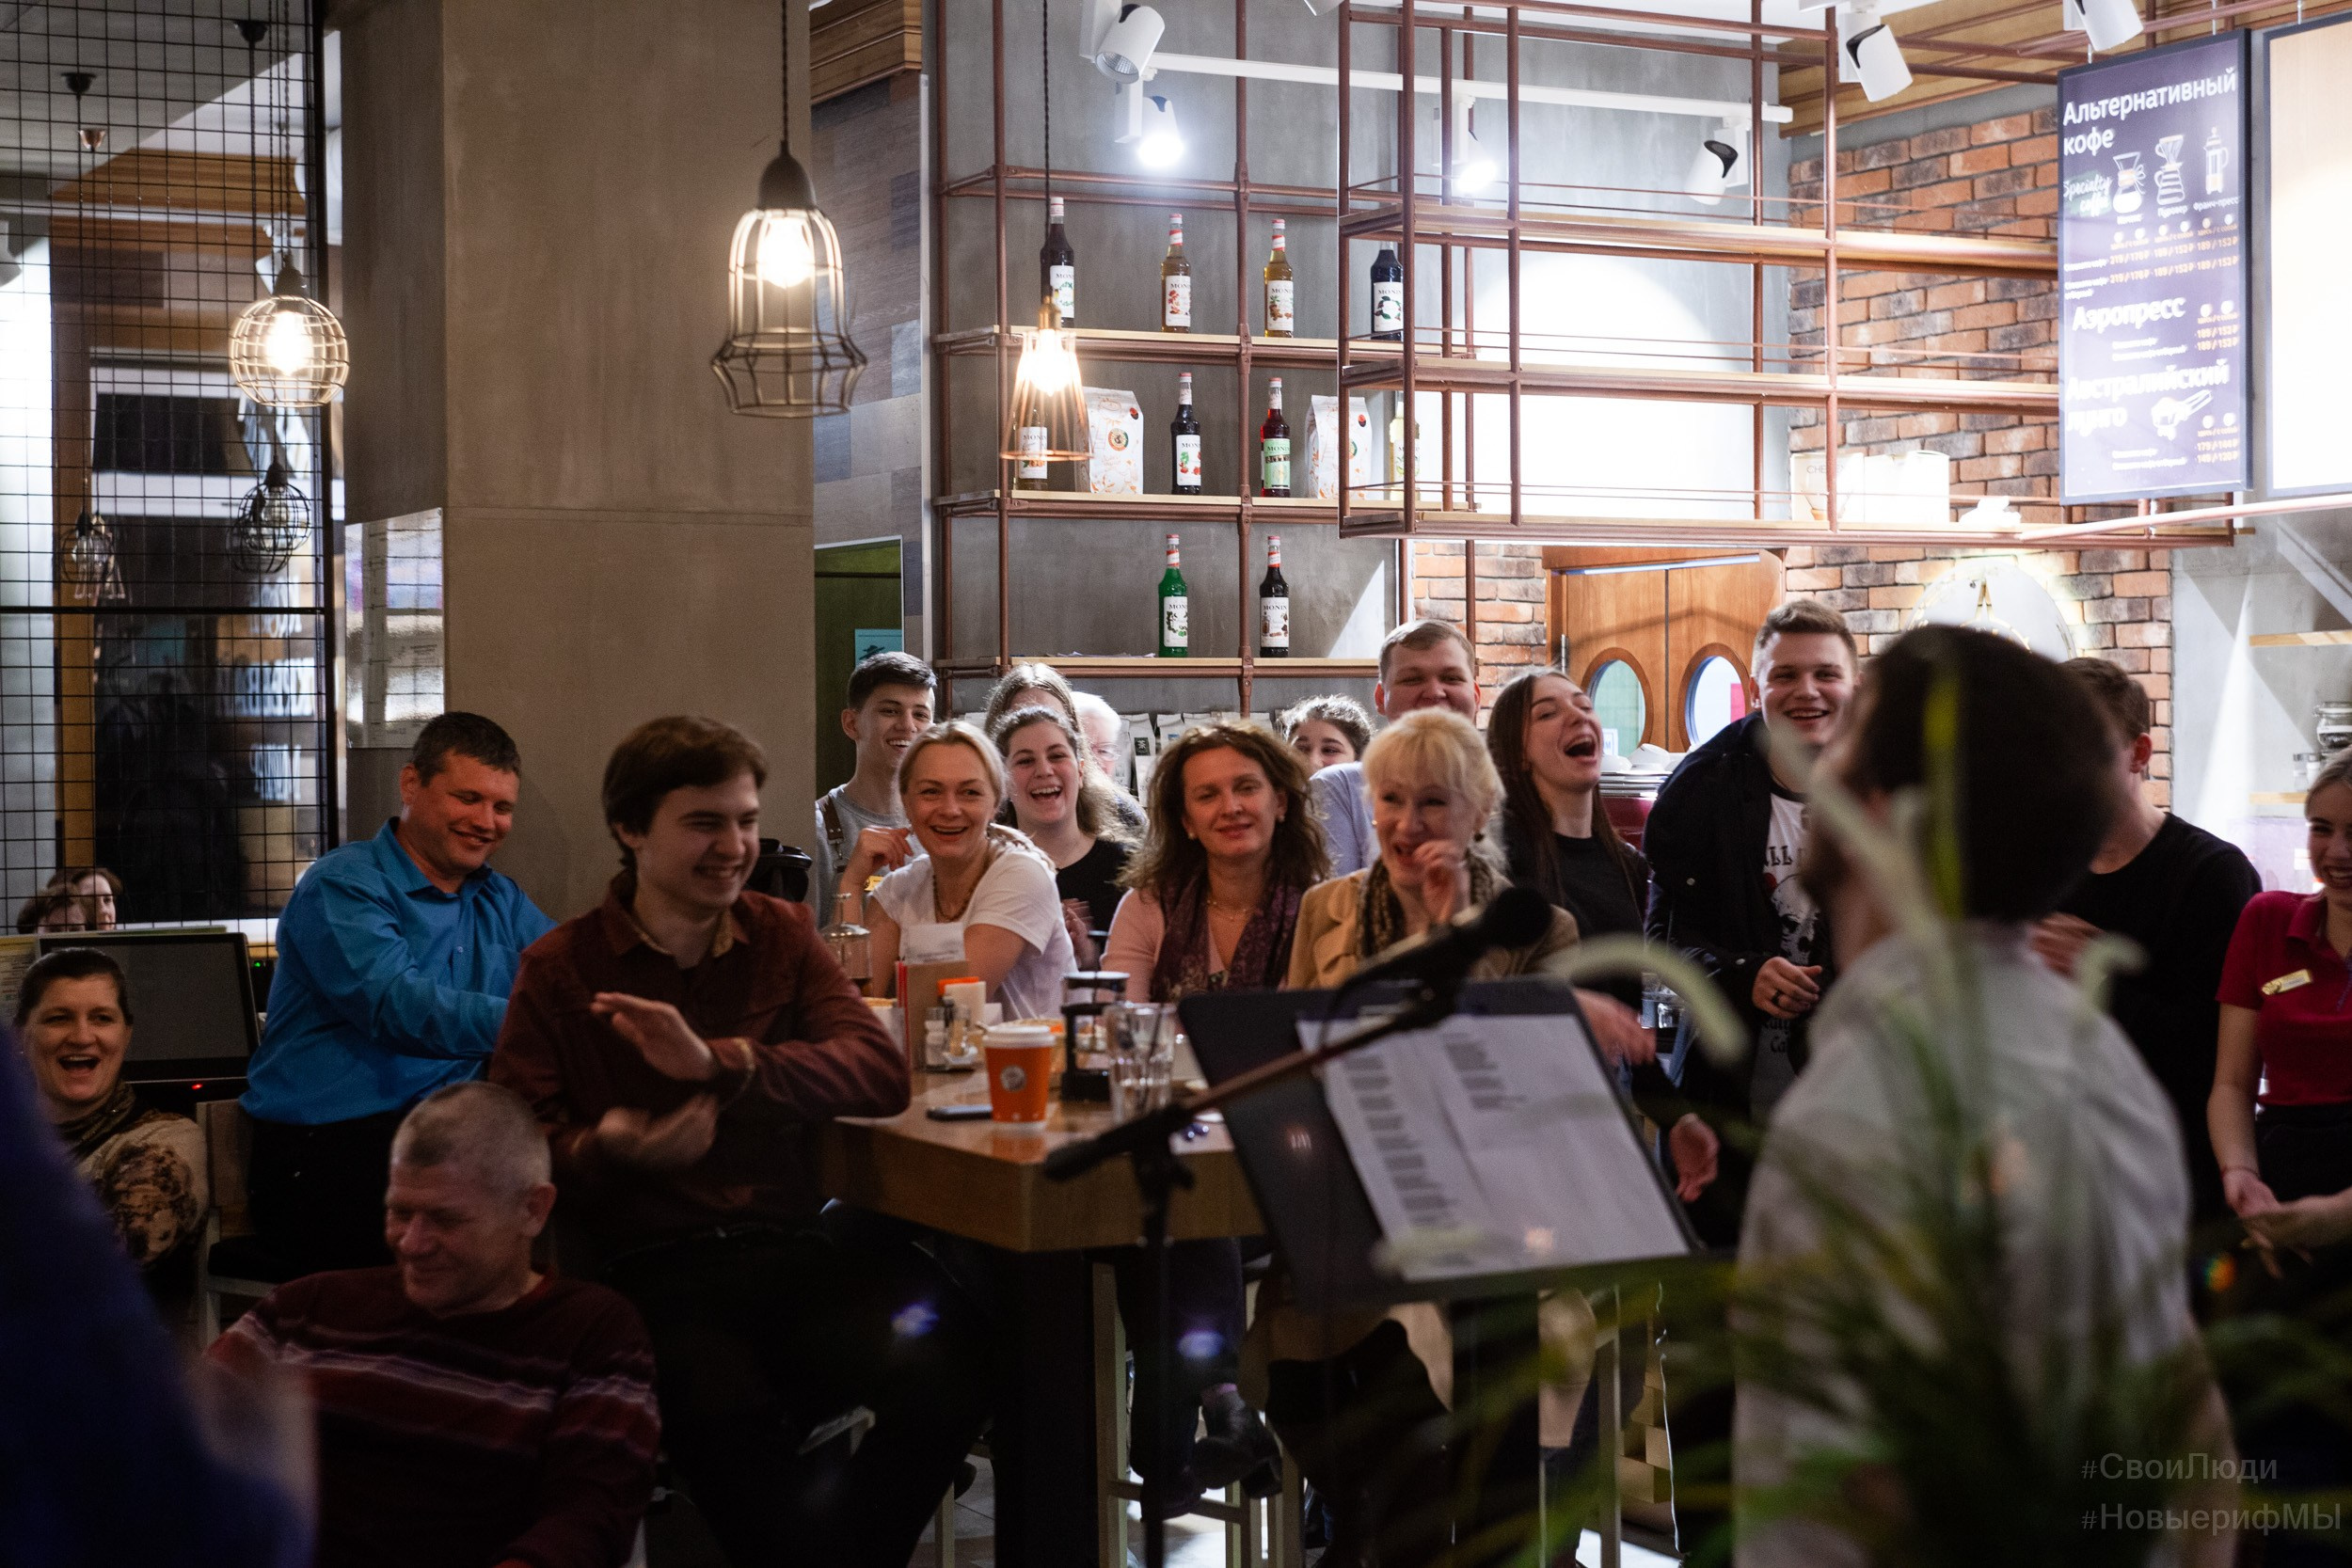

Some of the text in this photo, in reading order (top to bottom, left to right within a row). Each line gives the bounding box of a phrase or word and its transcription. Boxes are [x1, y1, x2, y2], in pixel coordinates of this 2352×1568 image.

[2062, 66, 2237, 126] Альтернативный
[2063, 127, 2115, 156] кофе
[2073, 297, 2185, 334] Аэропресс
